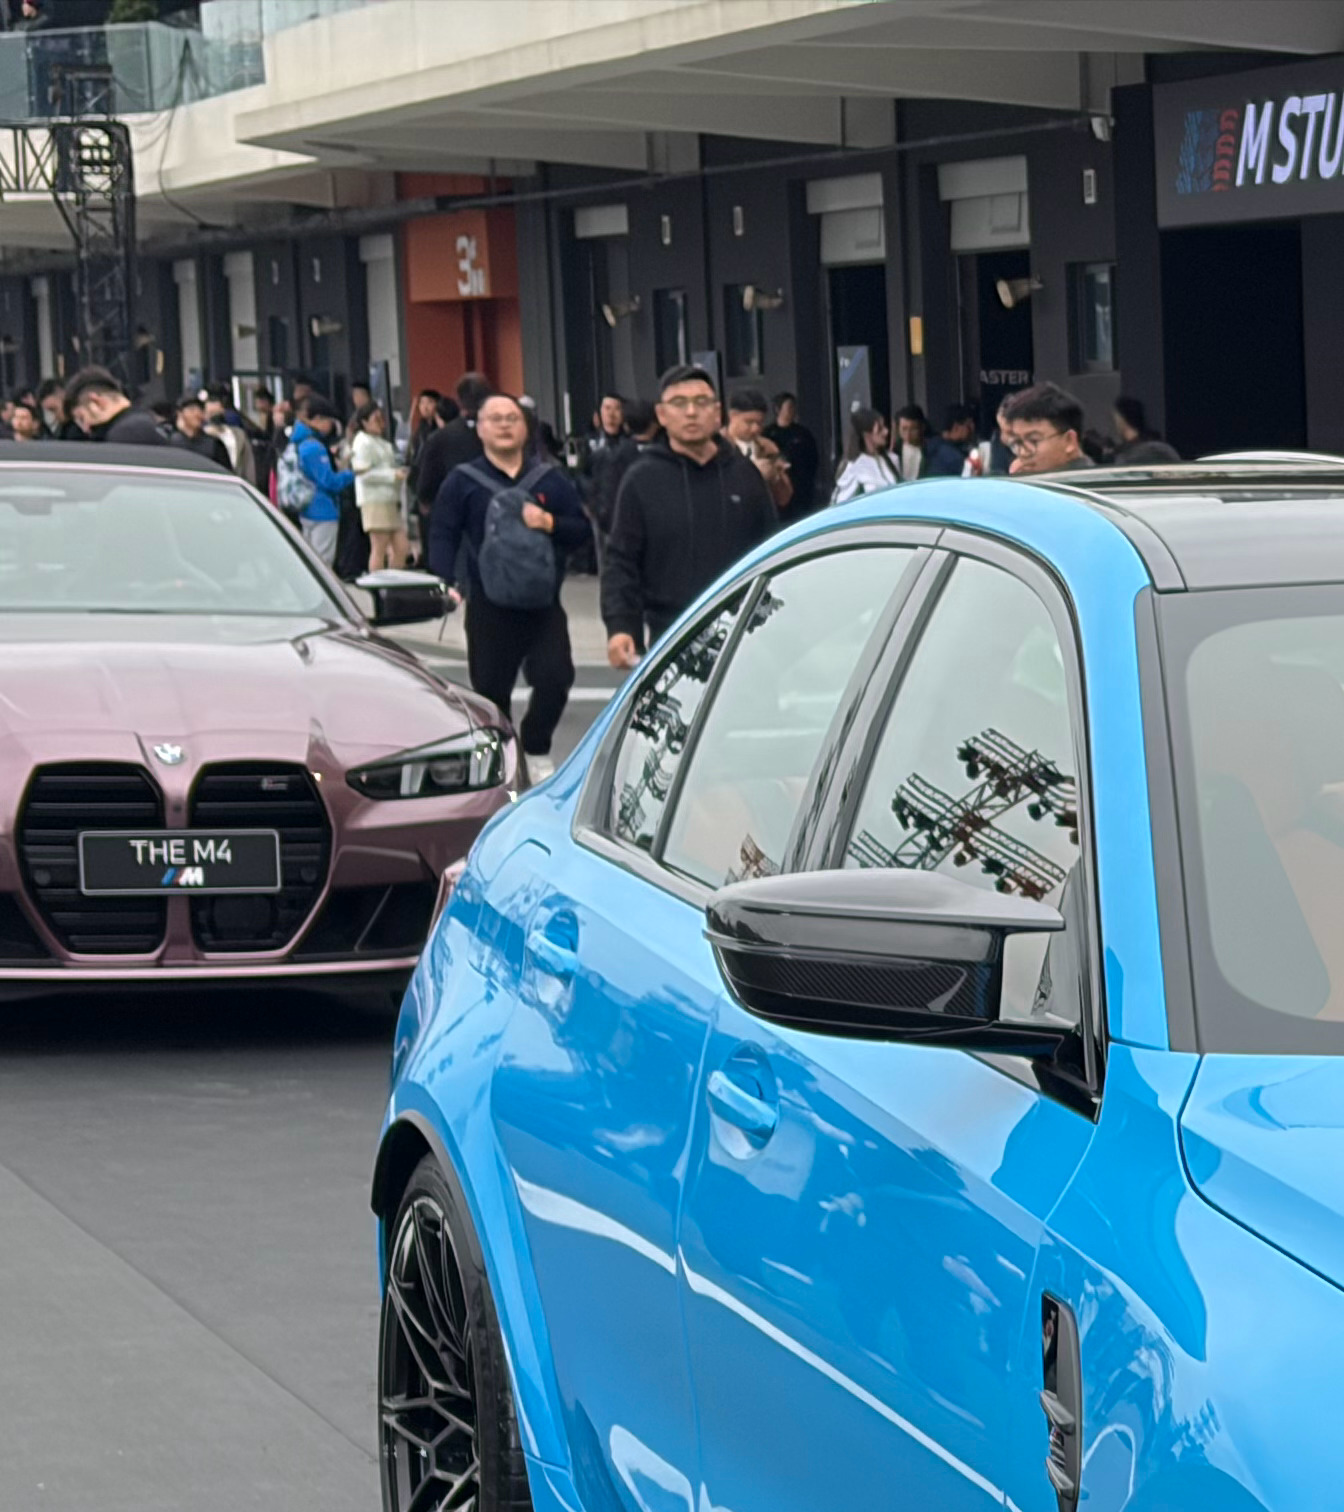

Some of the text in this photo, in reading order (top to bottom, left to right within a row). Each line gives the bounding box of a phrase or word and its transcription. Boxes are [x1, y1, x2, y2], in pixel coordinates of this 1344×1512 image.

[1235, 101, 1274, 187] M
[129, 838, 233, 866] THE M4
